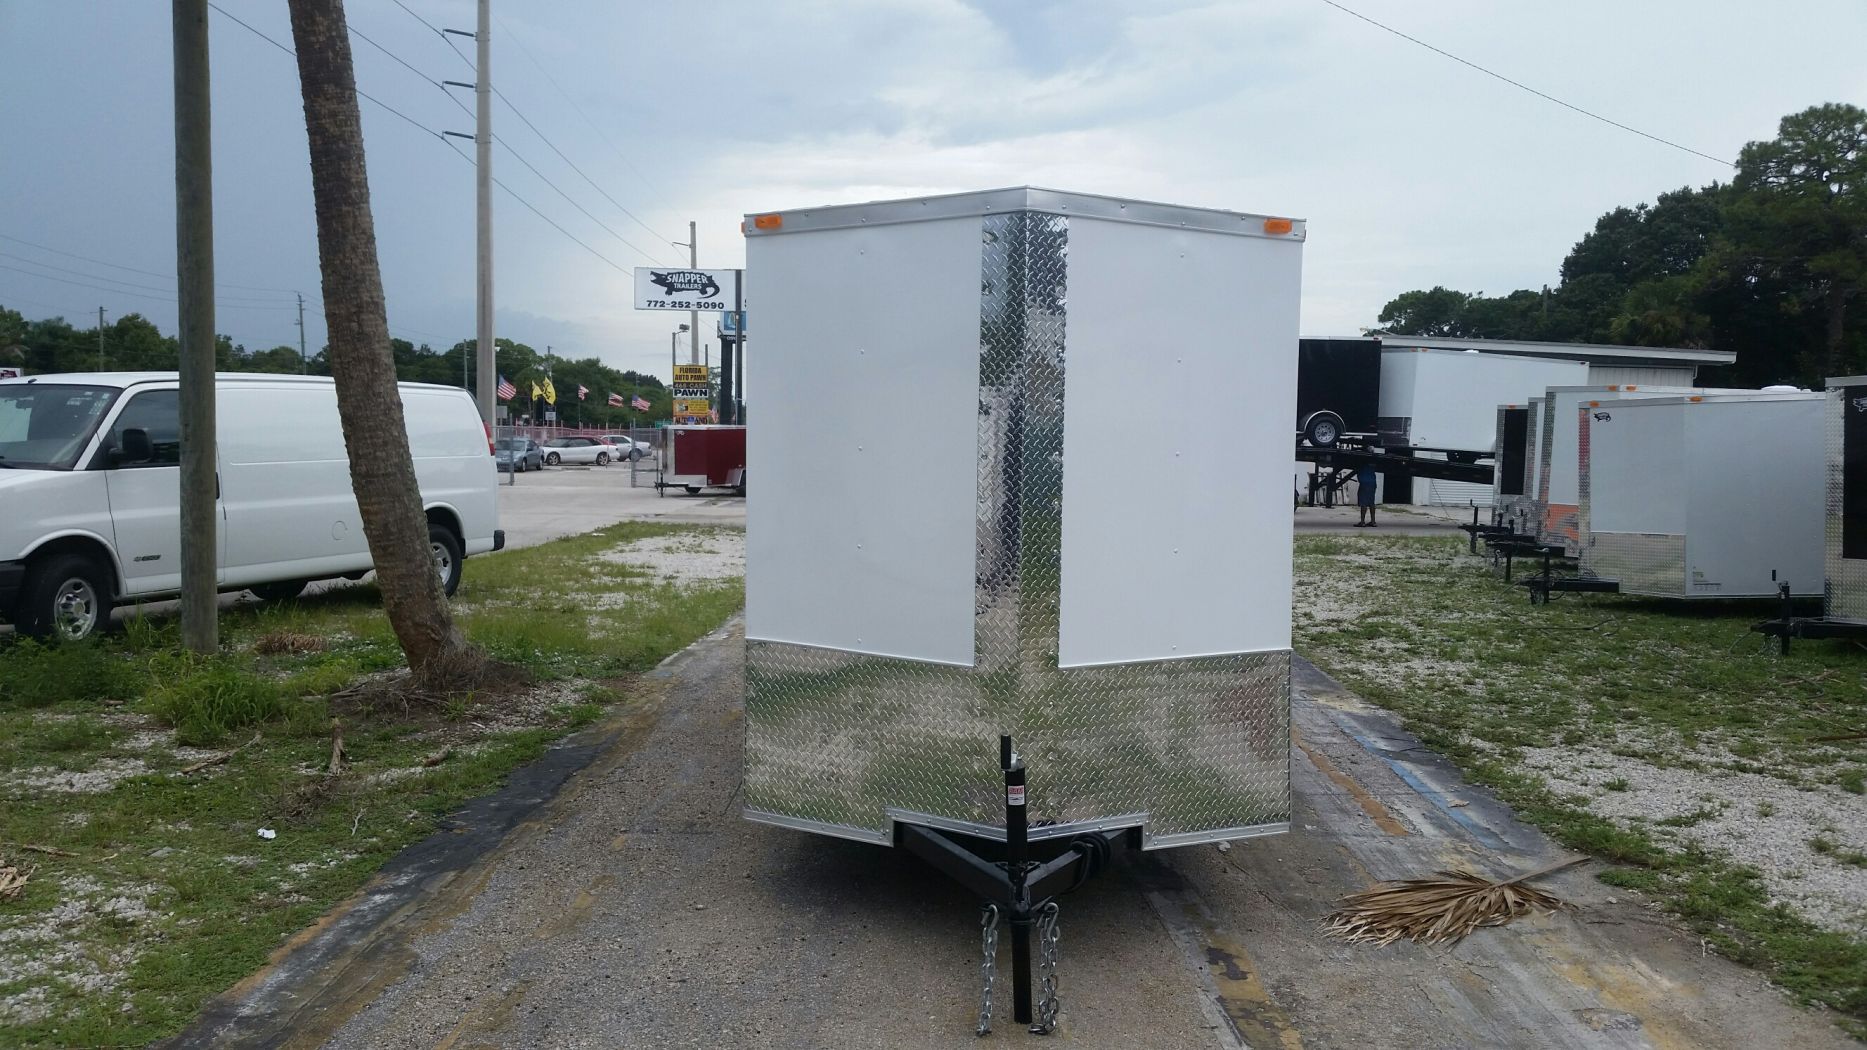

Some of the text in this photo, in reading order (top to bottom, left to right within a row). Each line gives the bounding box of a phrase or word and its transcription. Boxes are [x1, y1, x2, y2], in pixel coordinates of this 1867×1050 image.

[666, 273, 709, 284] SNAPPER
[646, 300, 725, 309] 772-252-5090
[674, 389, 708, 397] PAWN
